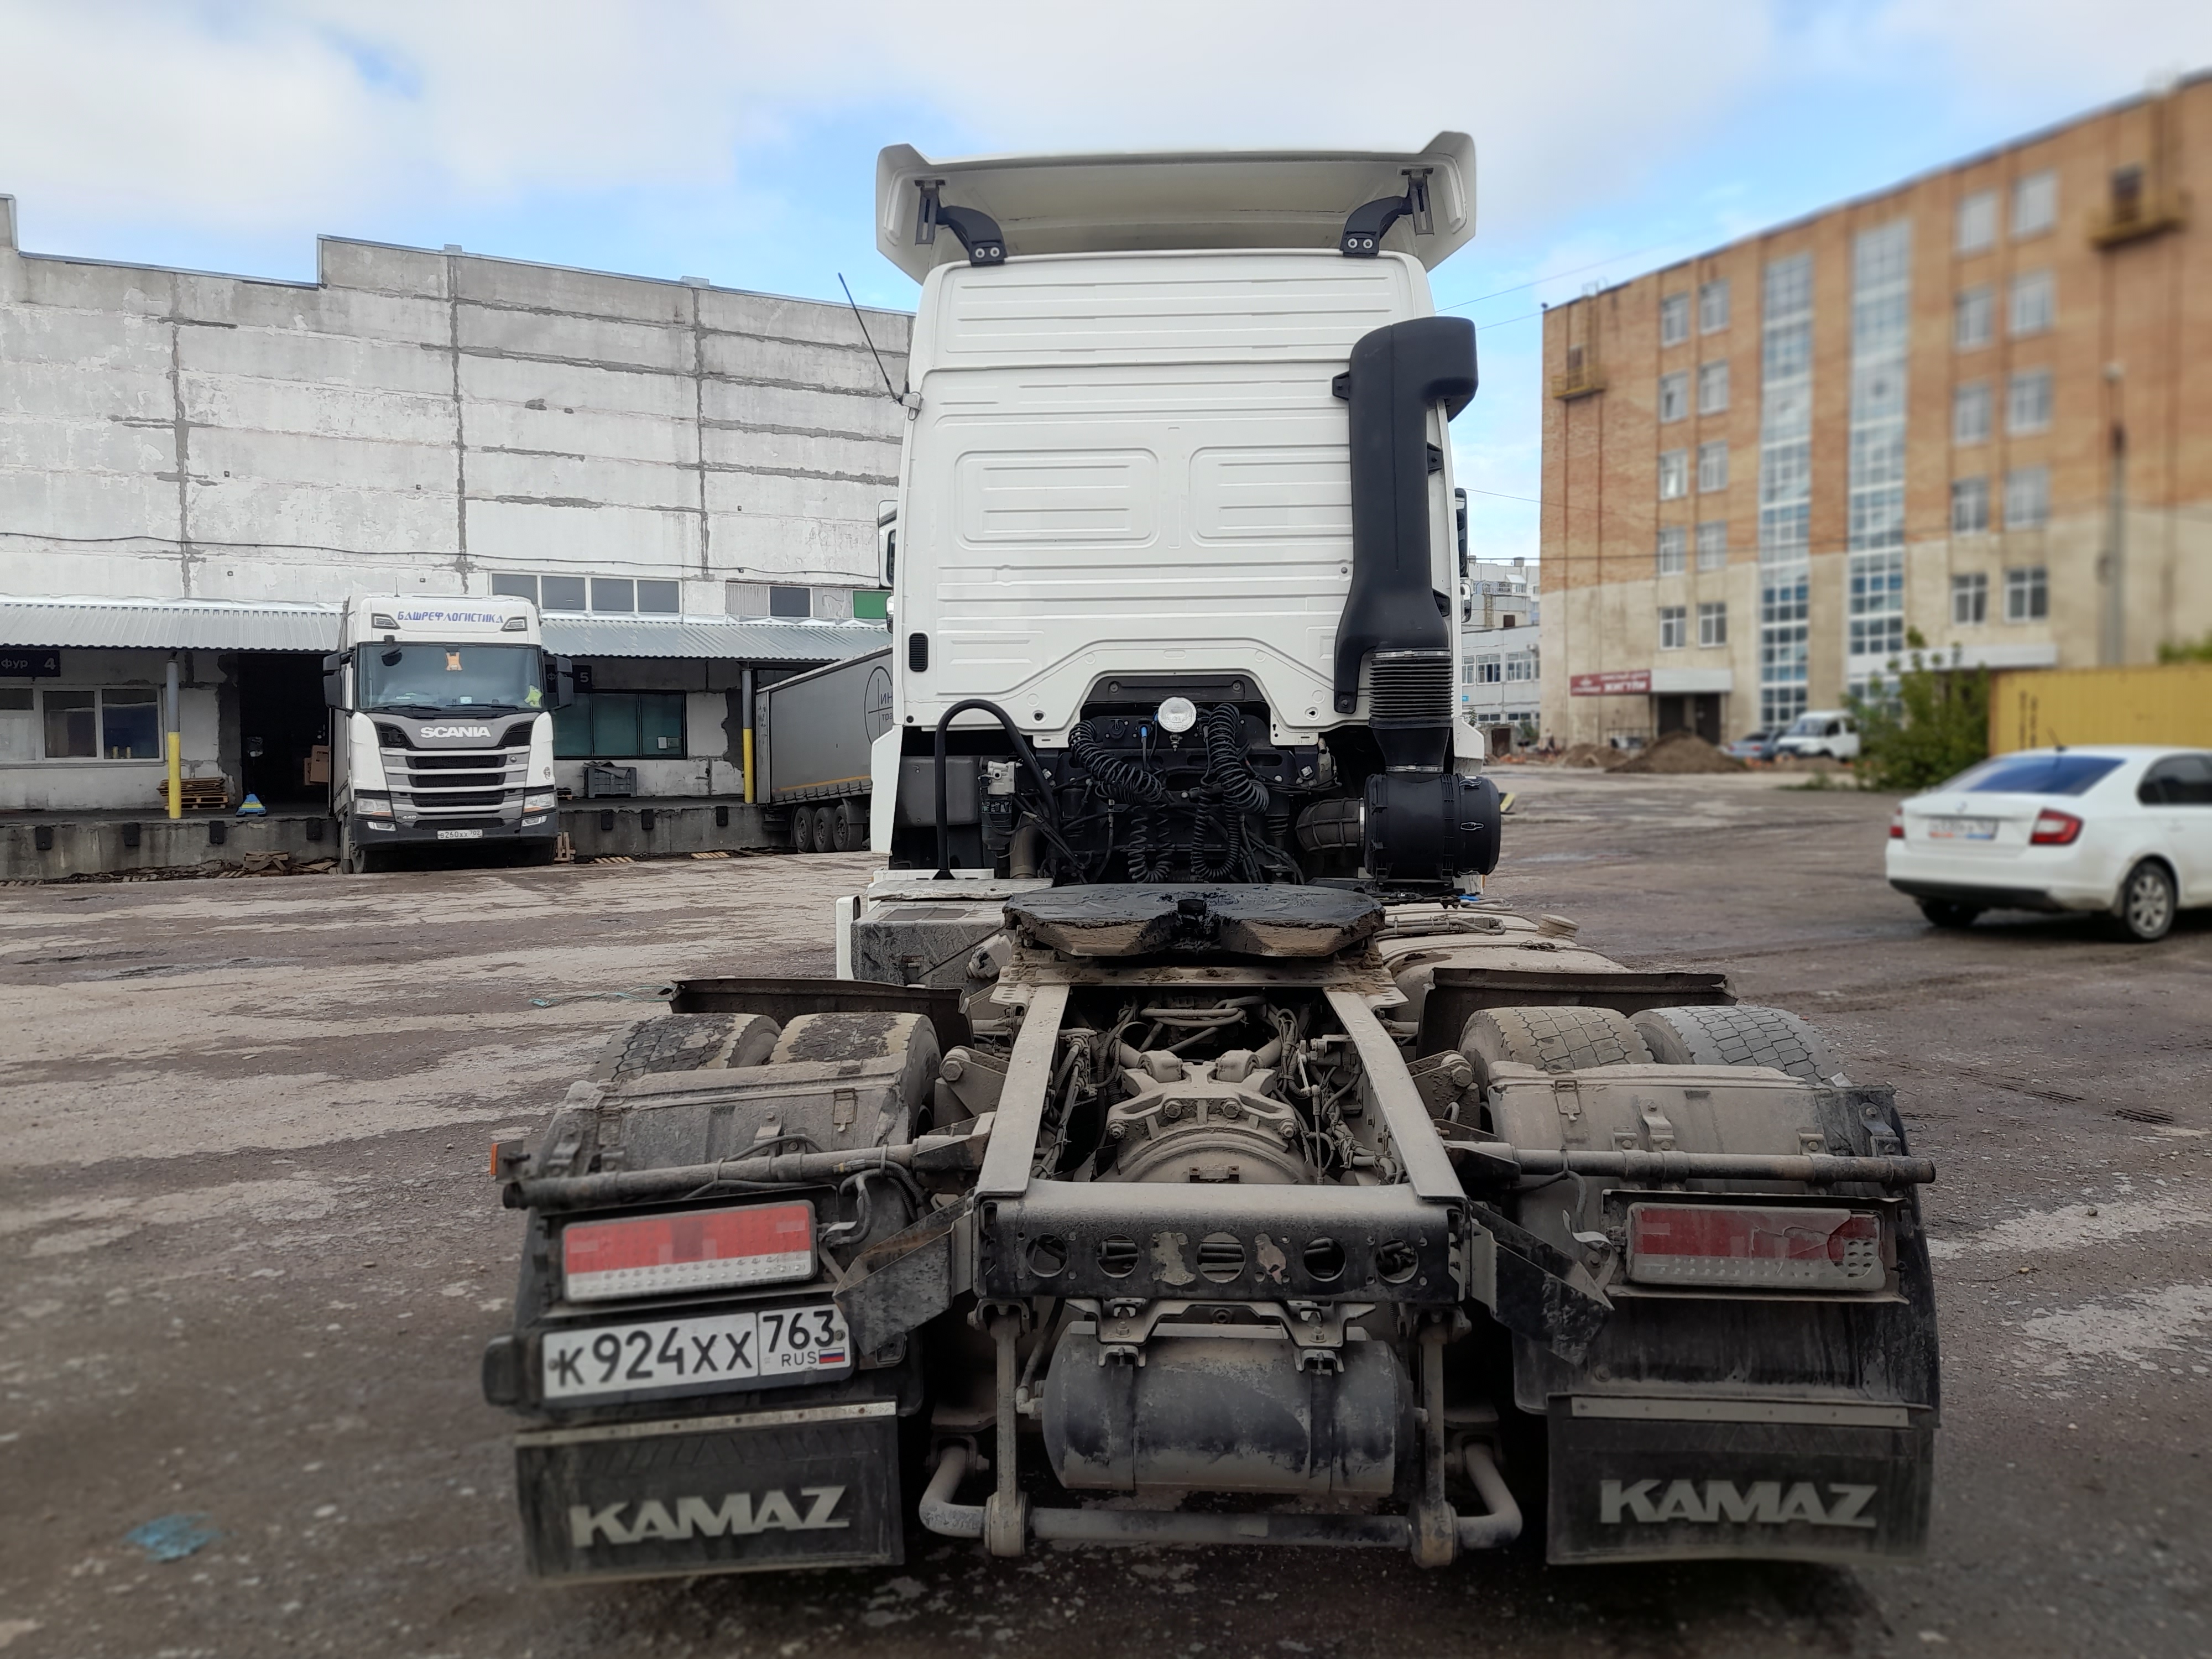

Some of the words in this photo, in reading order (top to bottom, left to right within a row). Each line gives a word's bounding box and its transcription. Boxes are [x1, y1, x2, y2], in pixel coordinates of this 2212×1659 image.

[398, 611, 504, 623] БАШРЕФЛОГИСТИКА
[1, 658, 28, 669] фур
[44, 657, 56, 670] 4
[580, 671, 589, 683] 5
[420, 726, 492, 738] SCANIA
[559, 1327, 753, 1387] К924ХХ
[762, 1310, 834, 1353] 763
[781, 1351, 817, 1368] RUS
[1600, 1479, 1878, 1528] KAMAZ
[568, 1485, 850, 1548] KAMAZ
